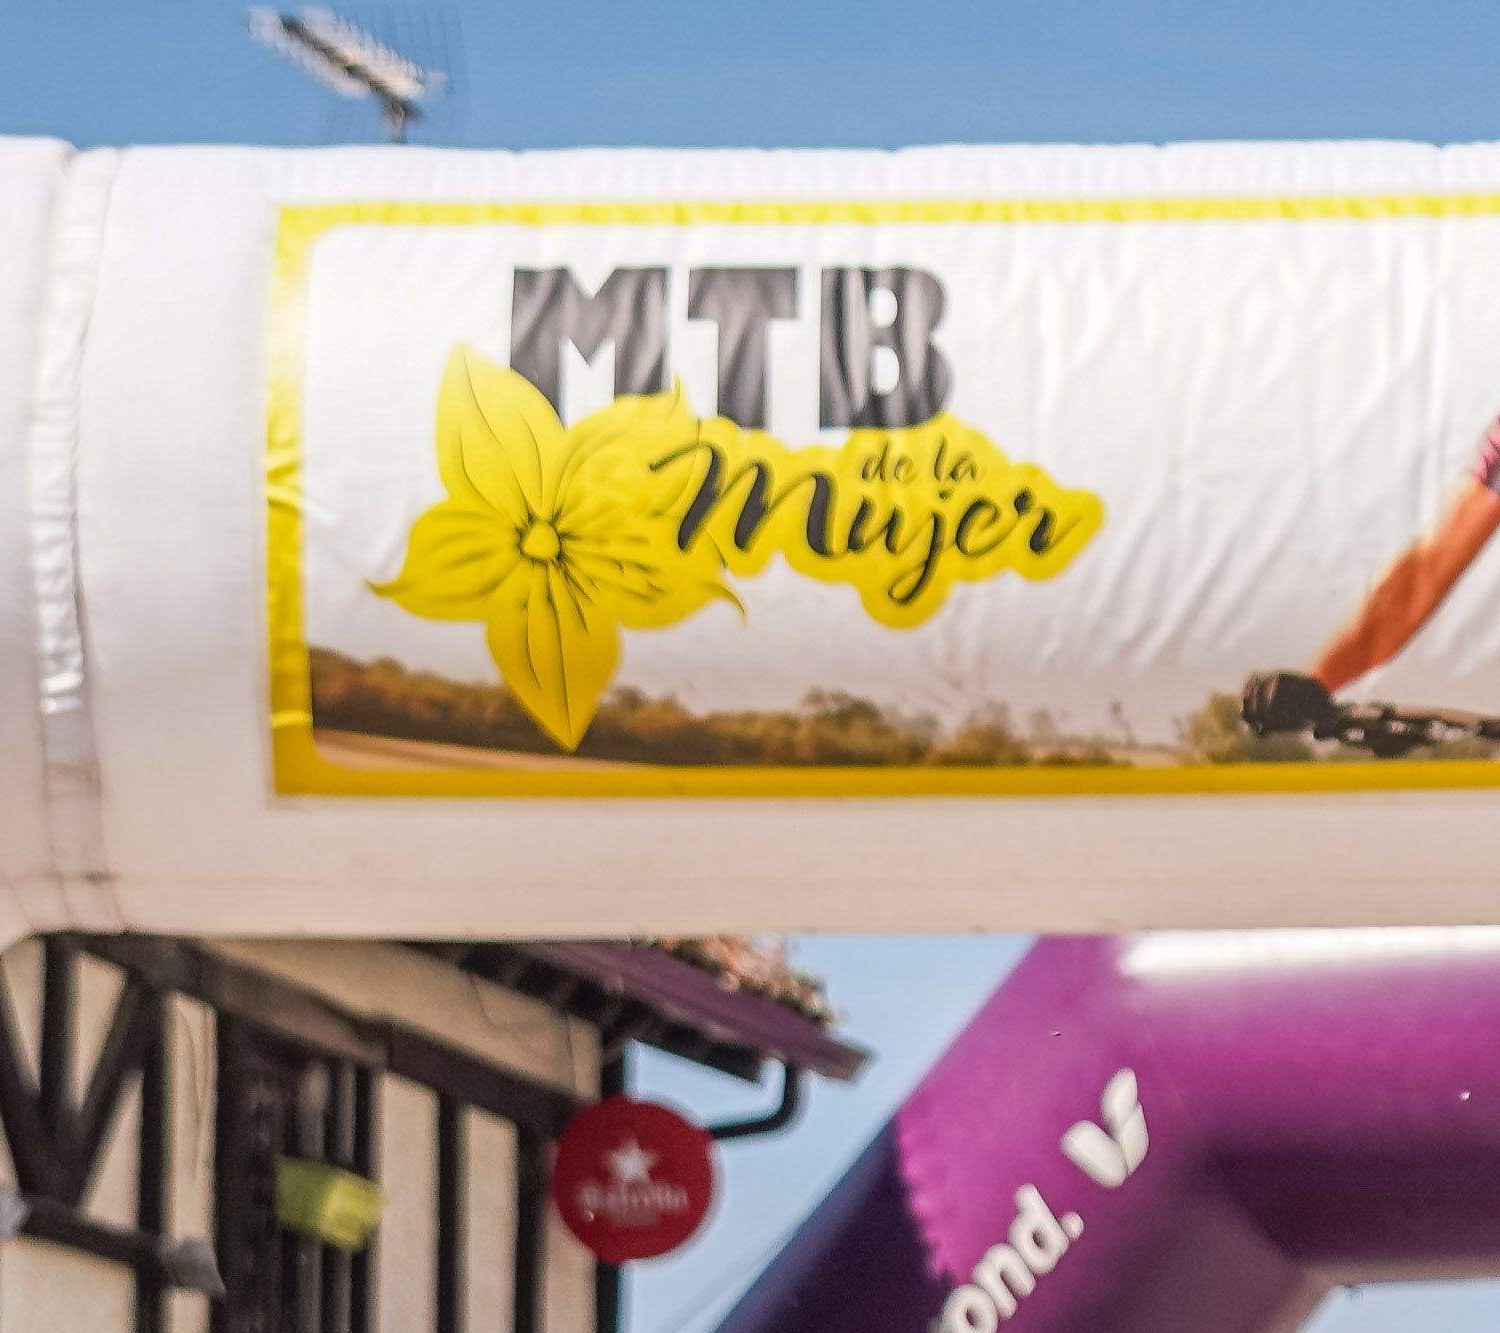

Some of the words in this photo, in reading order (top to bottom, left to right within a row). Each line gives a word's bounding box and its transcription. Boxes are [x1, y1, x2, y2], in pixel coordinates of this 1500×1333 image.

[509, 265, 954, 430] MTB
[650, 438, 1082, 603] Mujer
[862, 436, 919, 483] de
[933, 435, 980, 483] la
